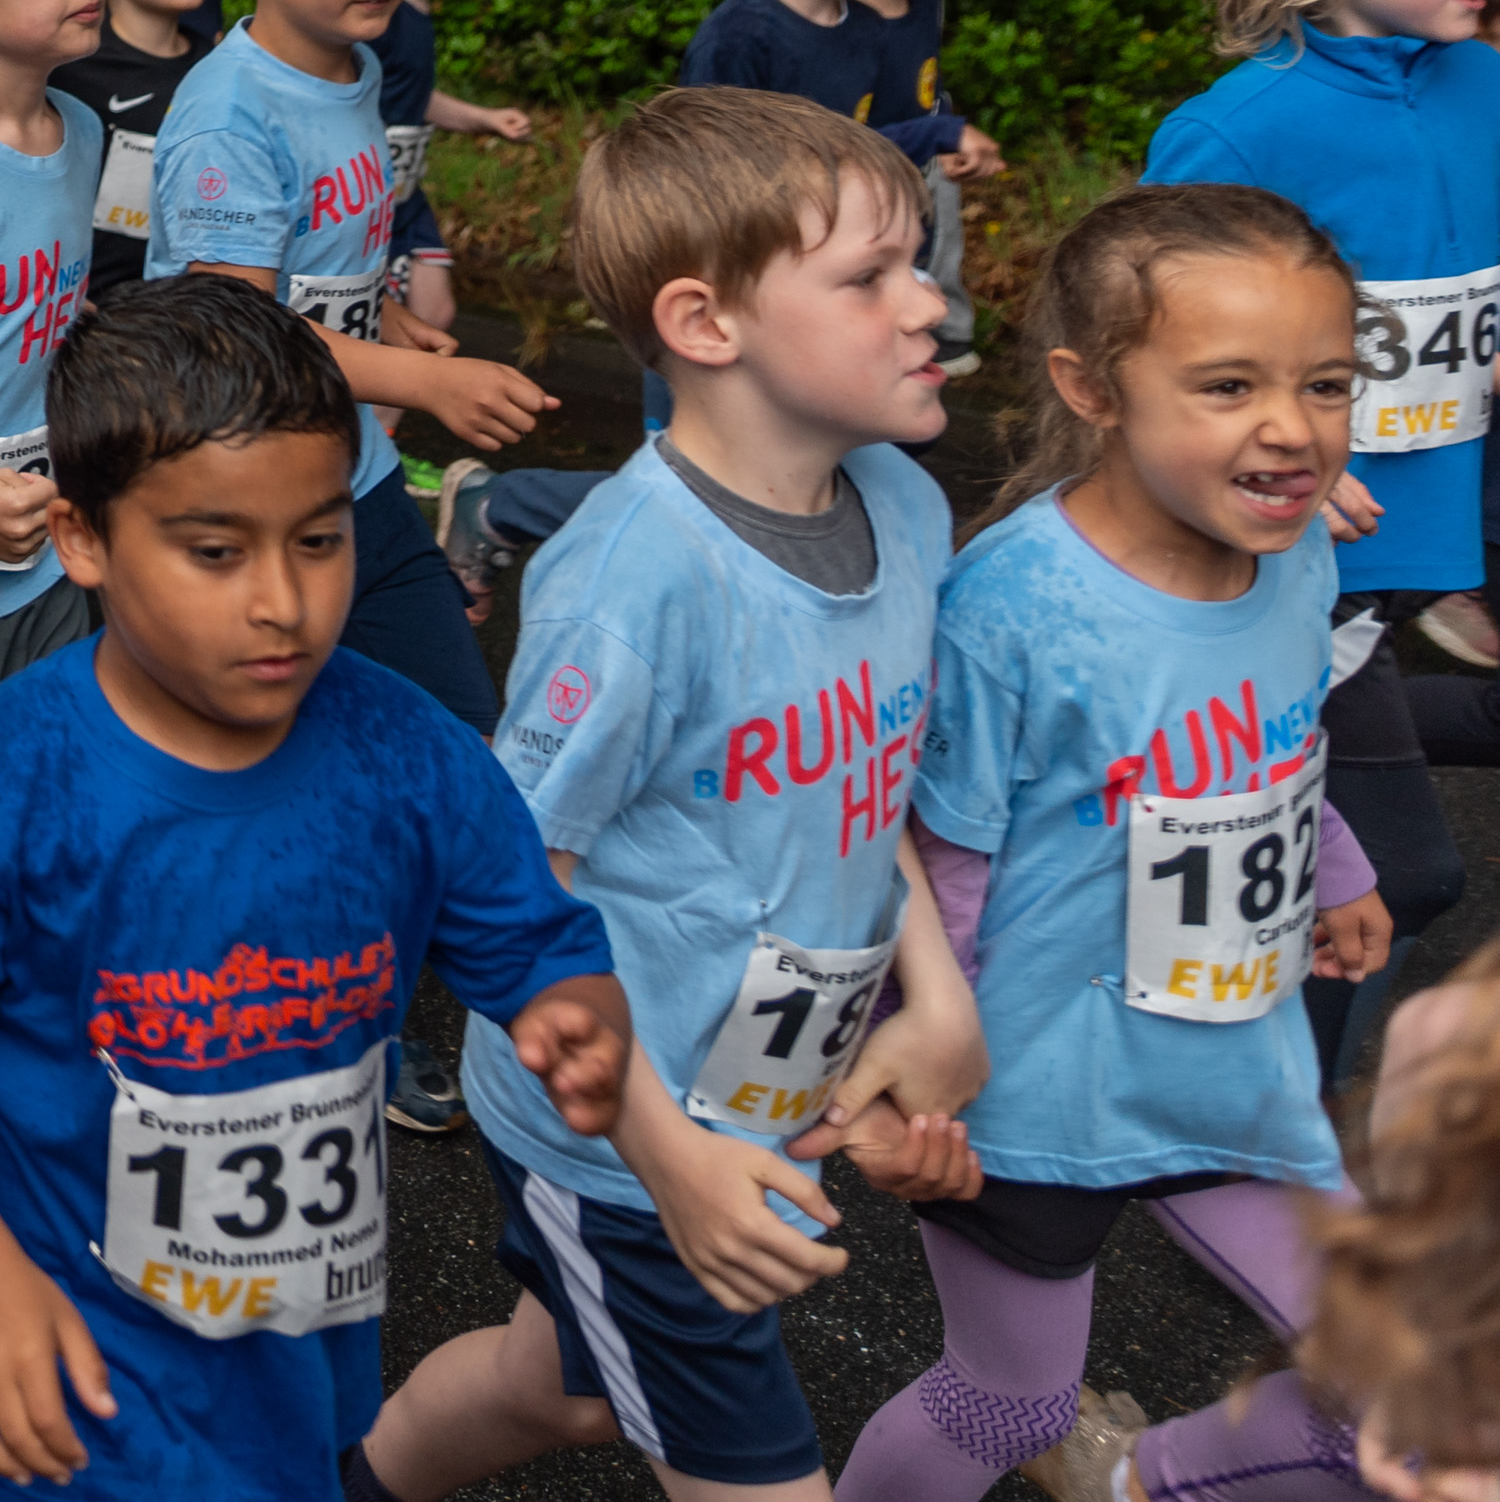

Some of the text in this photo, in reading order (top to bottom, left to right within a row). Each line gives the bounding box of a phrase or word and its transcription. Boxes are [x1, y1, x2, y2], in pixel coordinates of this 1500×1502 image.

[107, 205, 150, 229] EW
[1376, 399, 1459, 437] EWE
[1166, 949, 1280, 1002] EWE
[138, 1108, 284, 1136] Everstener
[166, 1236, 323, 1269] Mohammed
[139, 1259, 279, 1319] EWE
